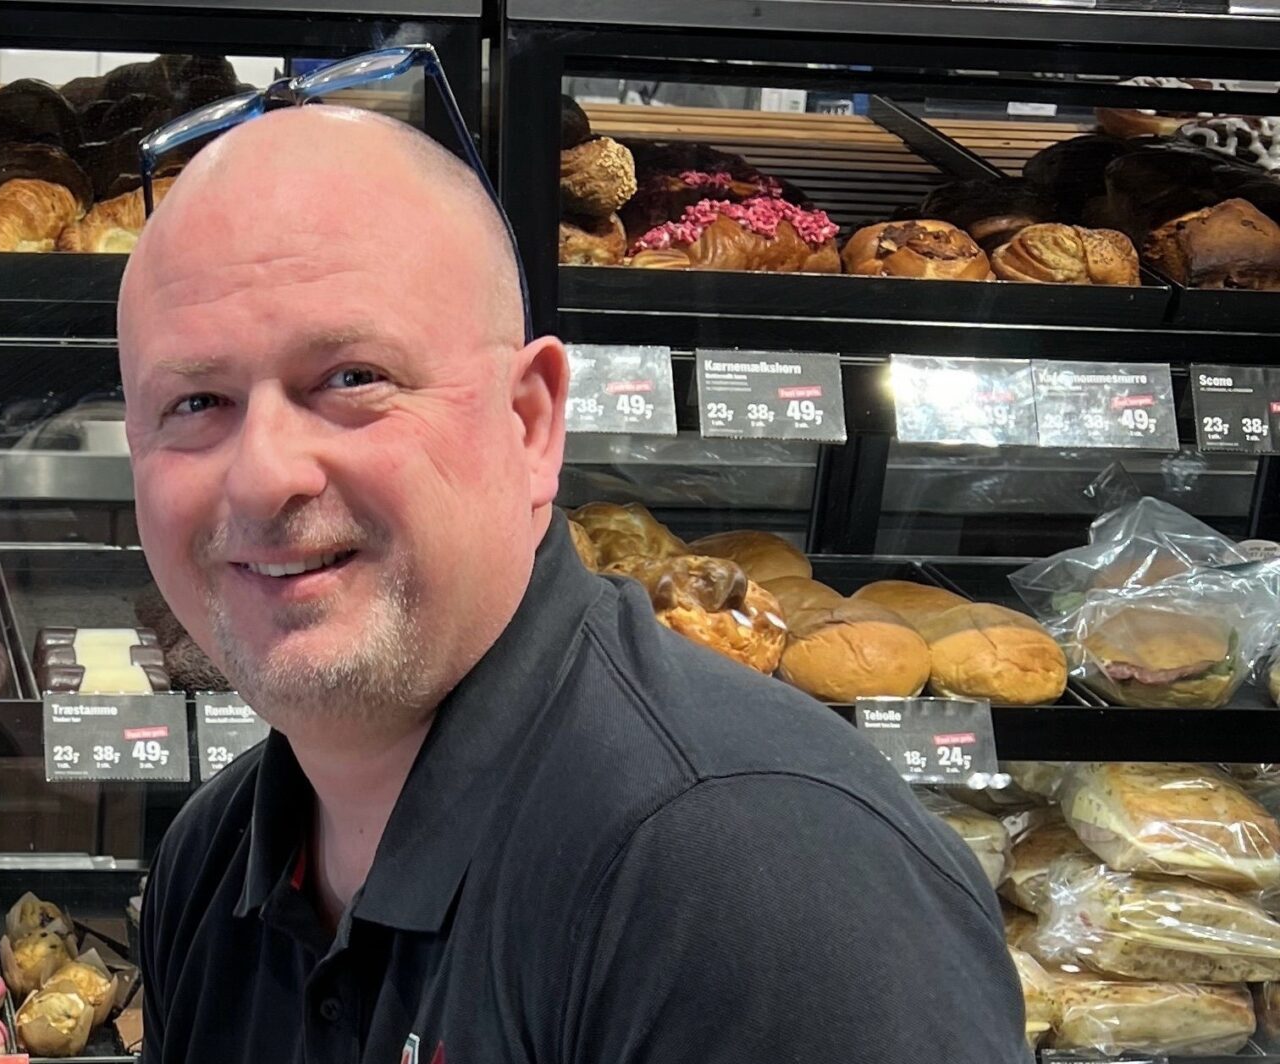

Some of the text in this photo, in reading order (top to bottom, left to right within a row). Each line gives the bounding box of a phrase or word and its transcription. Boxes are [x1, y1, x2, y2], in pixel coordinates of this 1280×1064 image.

[1199, 374, 1233, 387] Scone
[52, 704, 117, 715] Træstamme
[863, 709, 901, 721] Tebolle
